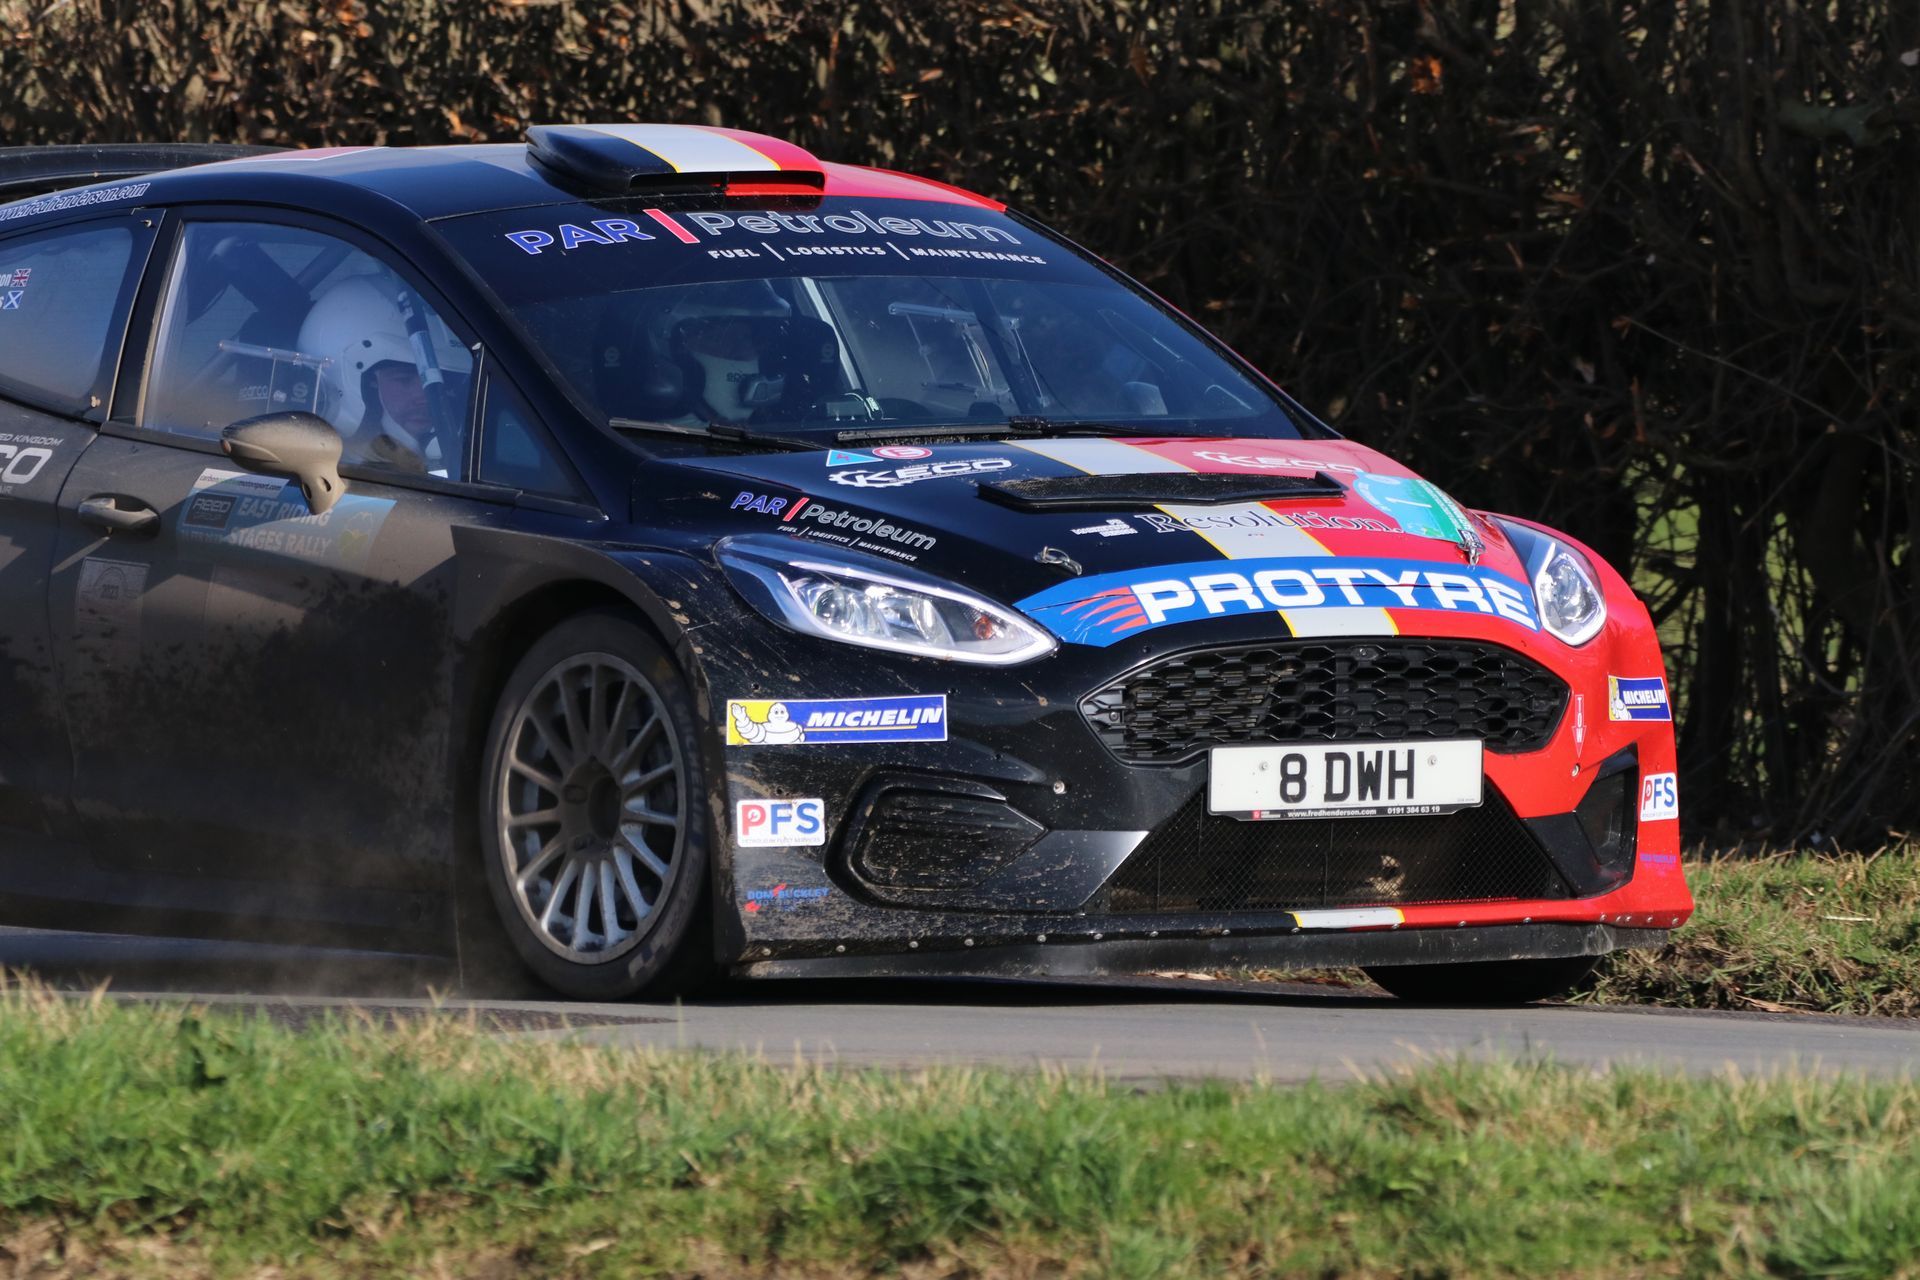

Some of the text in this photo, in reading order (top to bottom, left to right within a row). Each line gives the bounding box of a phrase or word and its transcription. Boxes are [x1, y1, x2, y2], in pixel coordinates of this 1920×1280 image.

[504, 211, 1022, 255] PAR Petroleum
[708, 247, 1047, 265] FUEL LOGISTICS MAINTENANCE
[14, 434, 64, 446] KINGDOM
[855, 459, 1012, 487] KECO
[238, 498, 334, 527] EAST RIDING
[730, 491, 937, 551] PAR Petroleum
[229, 527, 285, 551] STAGES
[285, 533, 333, 557] RALLY
[777, 525, 918, 562] FUEL LOGISTICS MAINTENANCE
[1131, 568, 1538, 627] PROTYRE
[1622, 689, 1667, 705] MICHELIN
[807, 707, 943, 728] MICHELIN
[1575, 696, 1583, 743] TOW
[1279, 749, 1416, 804] 8 DWH
[1642, 776, 1676, 811] PFS
[741, 802, 820, 836] PFS
[1288, 808, 1377, 818] www.fredhenderson.com
[1387, 807, 1405, 815] 0191
